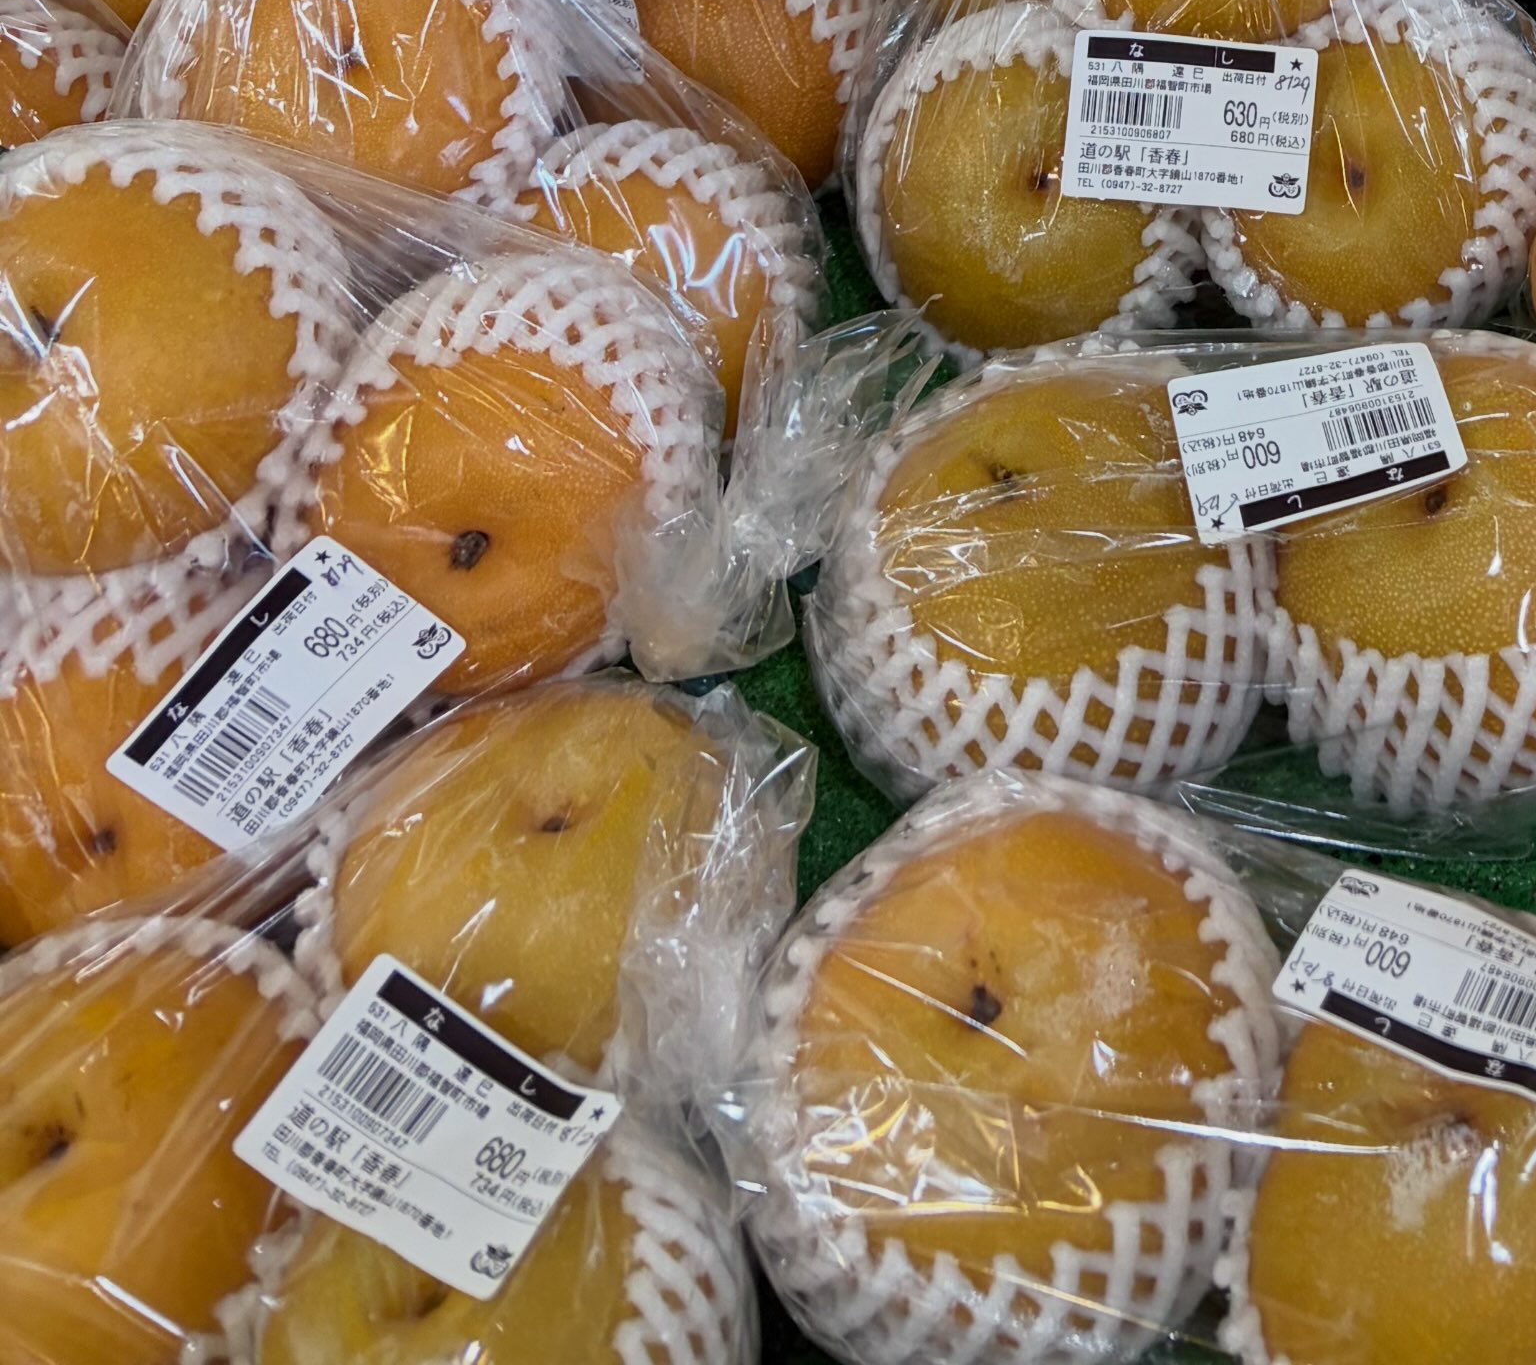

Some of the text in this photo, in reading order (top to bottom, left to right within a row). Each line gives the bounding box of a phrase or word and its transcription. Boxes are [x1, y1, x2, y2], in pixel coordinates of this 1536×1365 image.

[1222, 72, 1266, 86] 出荷日付
[1091, 125, 1171, 139] 2153100906807
[1077, 178, 1094, 187] TEL
